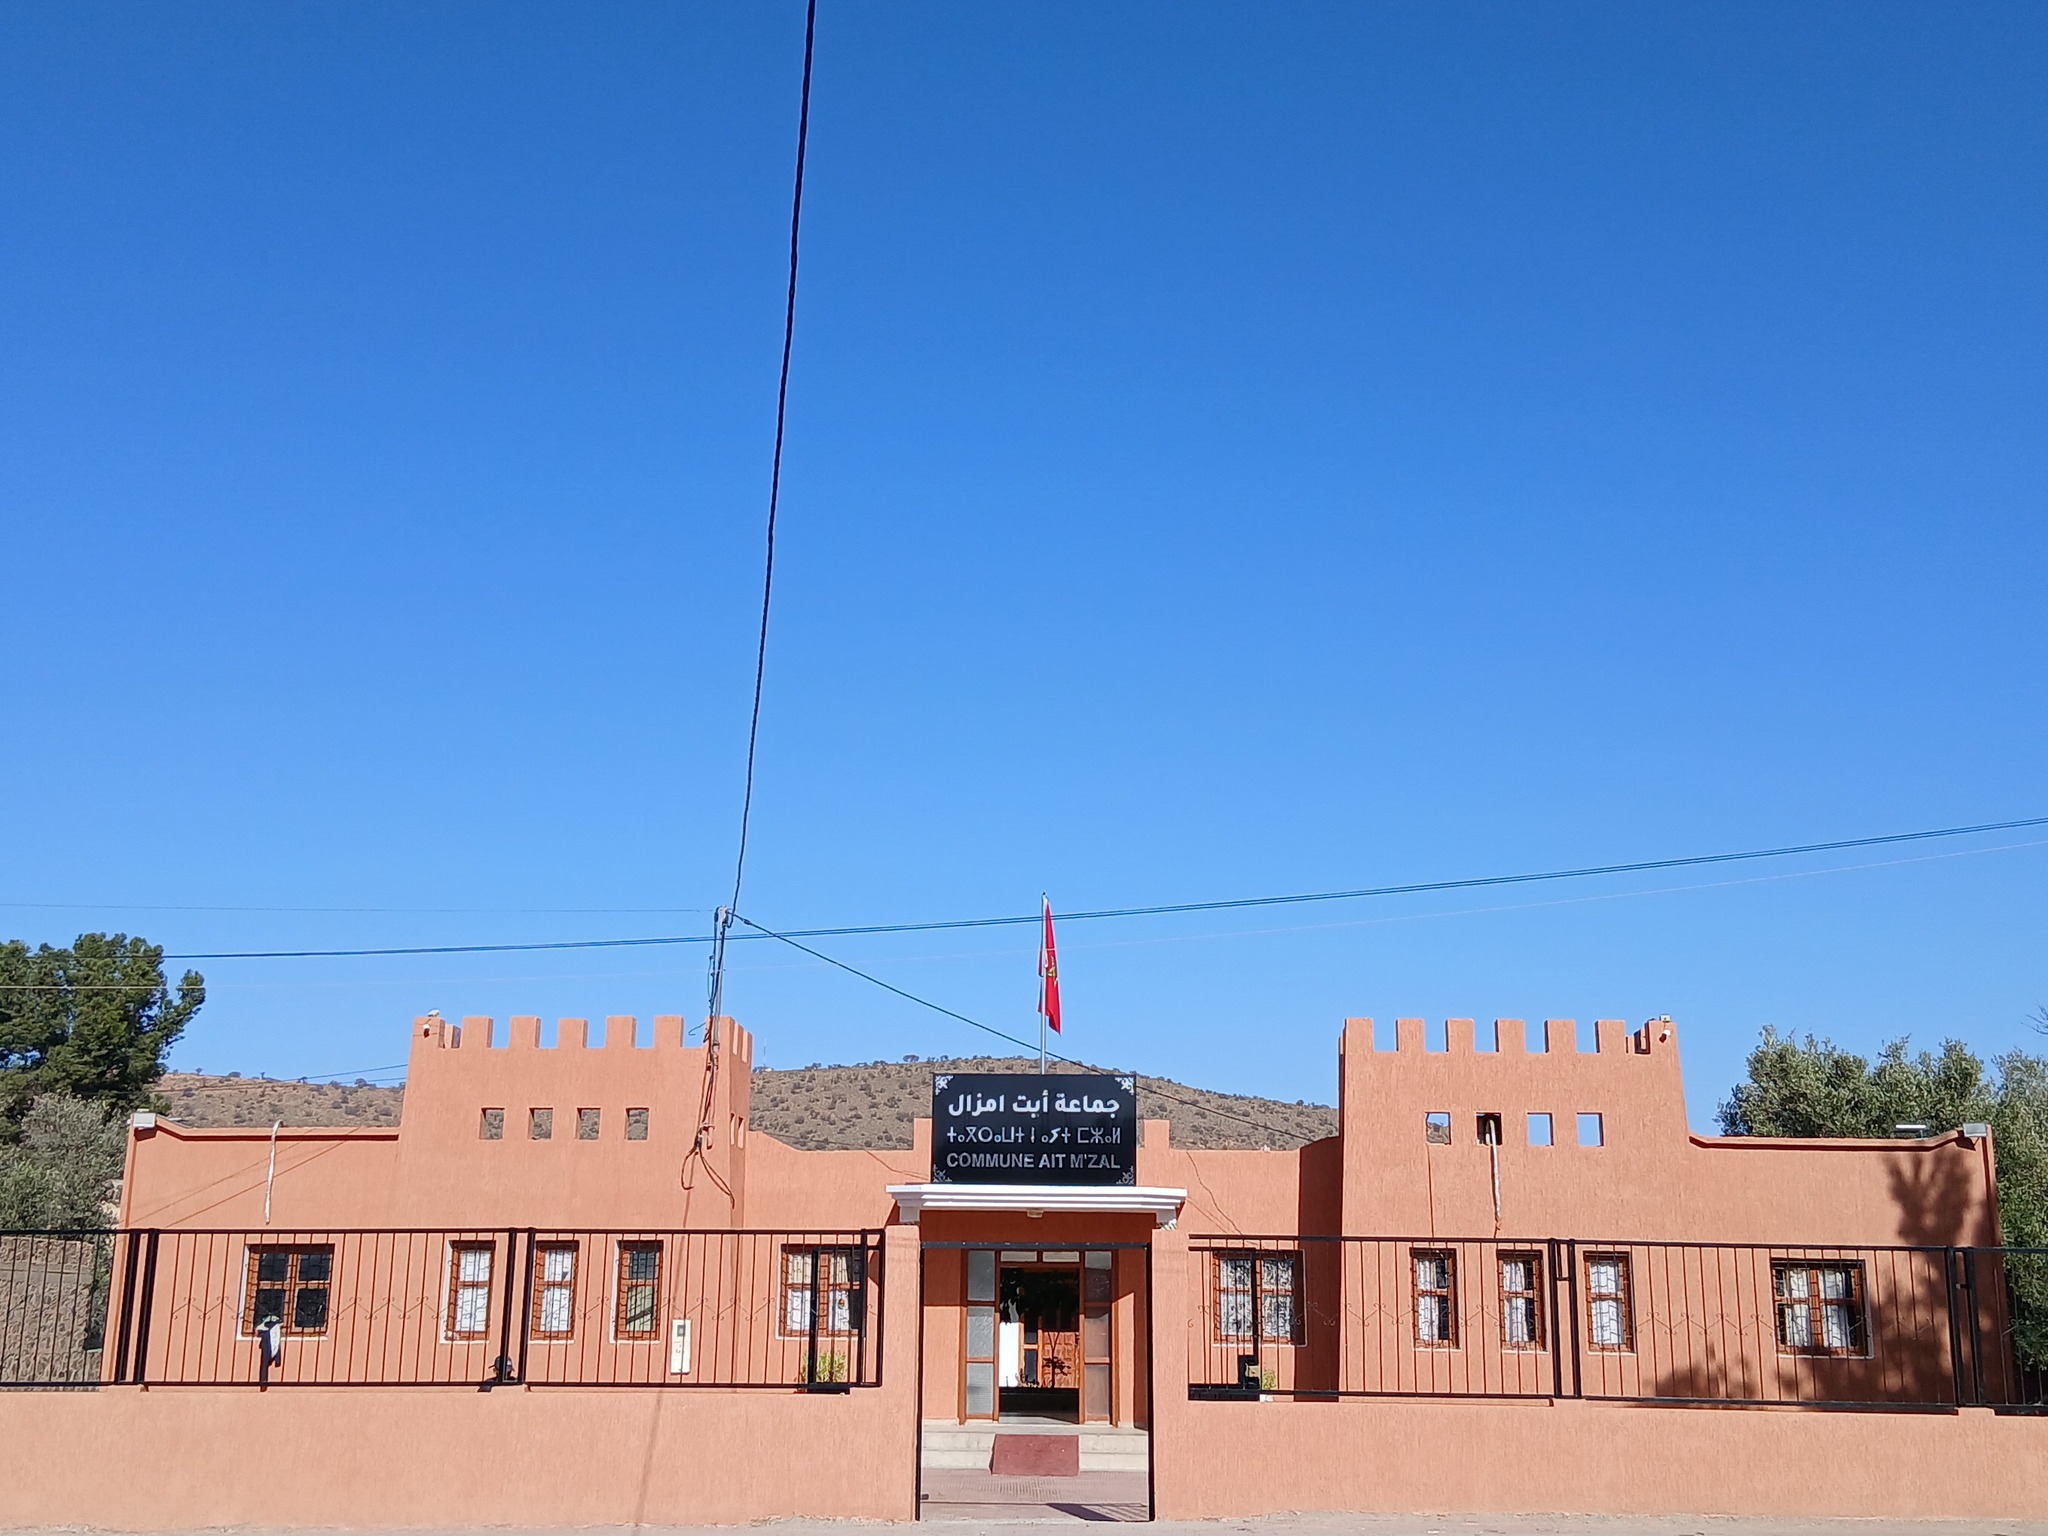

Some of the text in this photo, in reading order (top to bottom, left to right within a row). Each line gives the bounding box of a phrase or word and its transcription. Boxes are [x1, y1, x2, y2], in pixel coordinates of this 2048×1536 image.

[948, 1092, 1005, 1117] امزال
[1054, 1092, 1121, 1119] جماعة
[946, 1152, 1121, 1169] COMMUNE AIT M'ZAL
